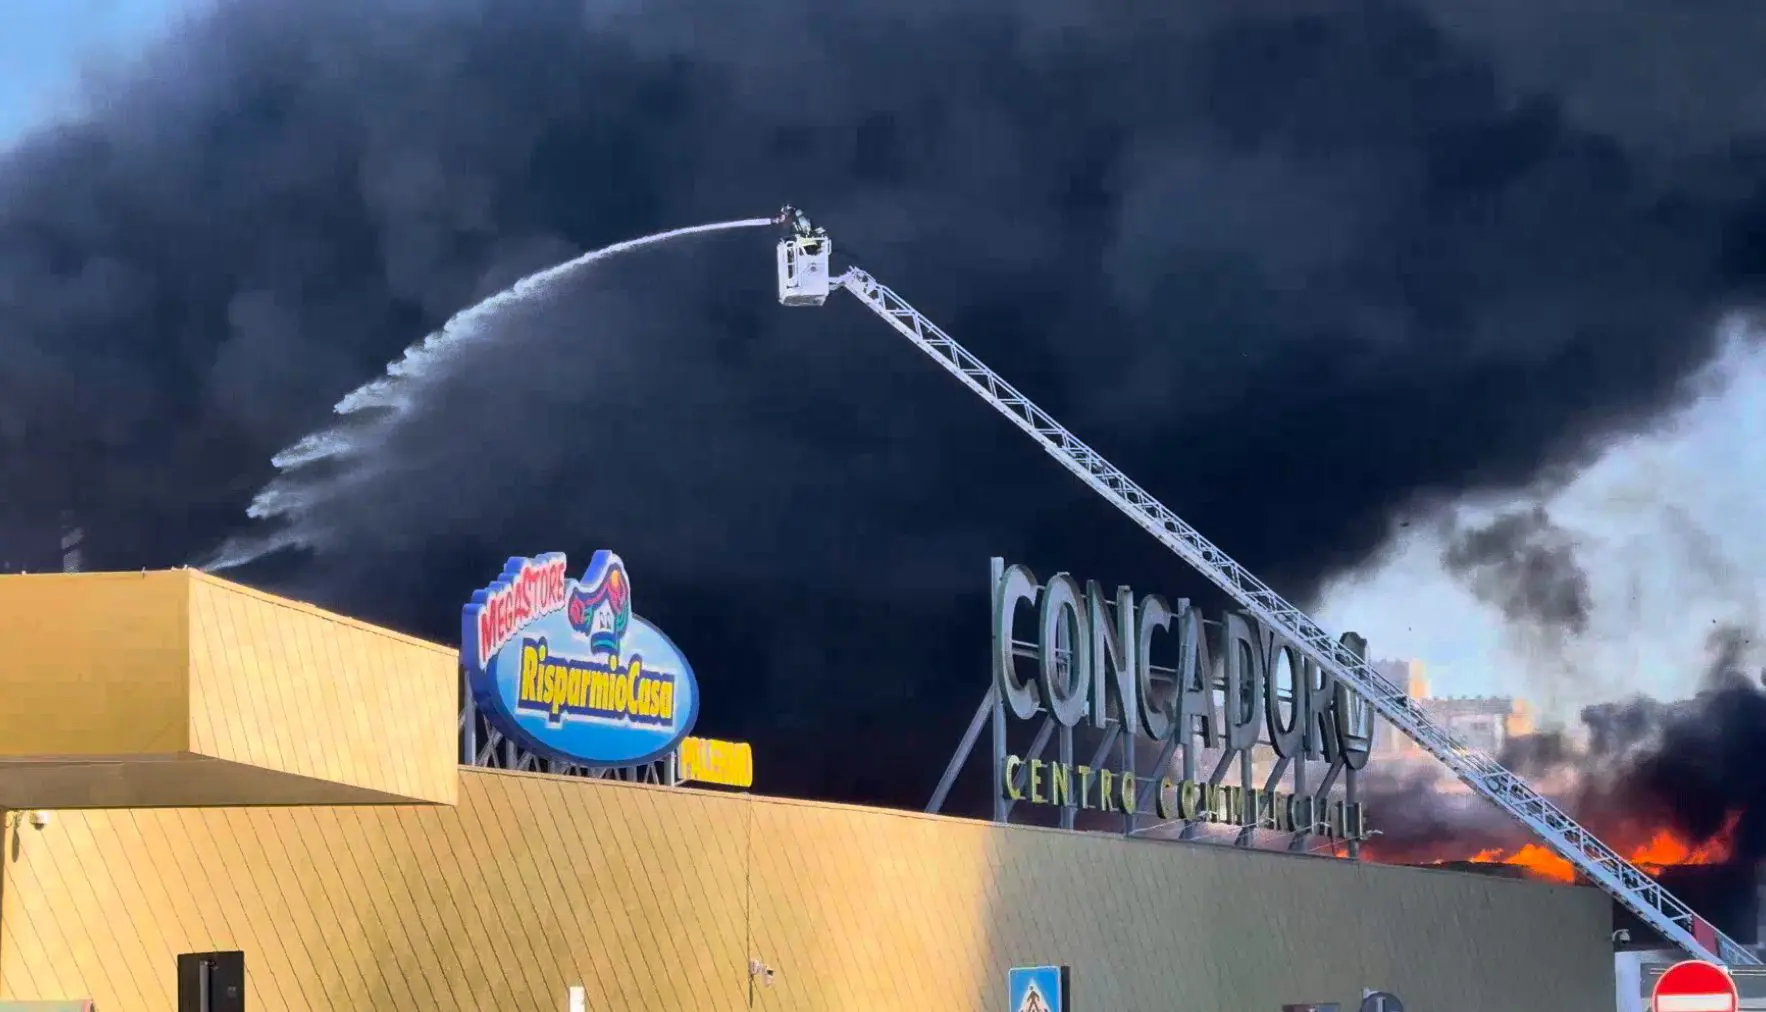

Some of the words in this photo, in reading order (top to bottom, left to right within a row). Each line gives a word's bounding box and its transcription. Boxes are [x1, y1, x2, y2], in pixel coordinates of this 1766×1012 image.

[480, 562, 566, 663] MEGASTORE
[521, 645, 672, 719] RisparmioCasa
[1003, 755, 1137, 815] CENTRO
